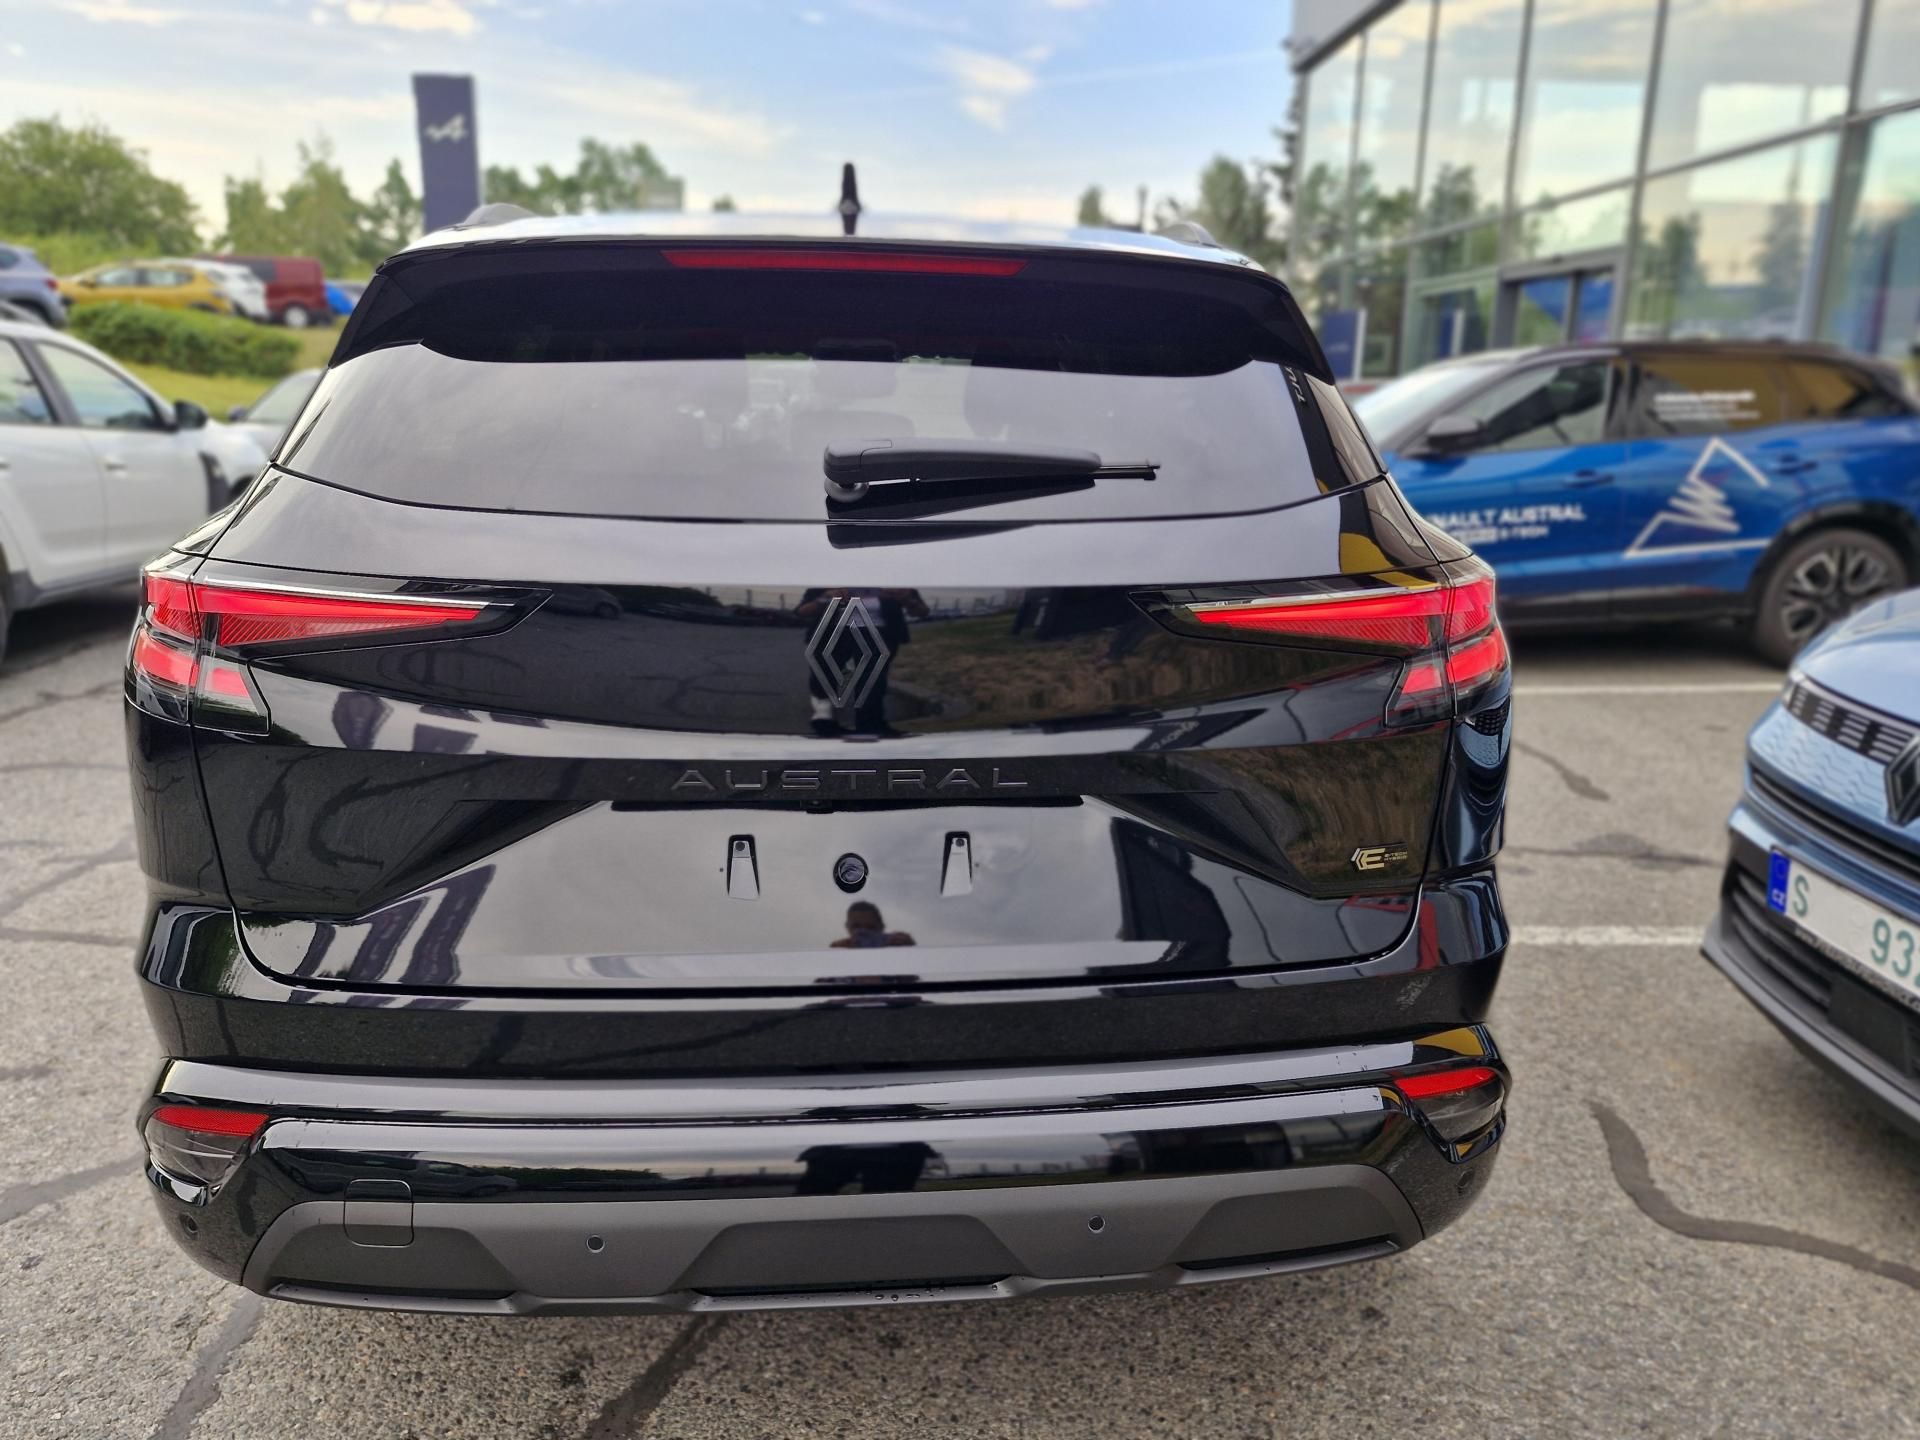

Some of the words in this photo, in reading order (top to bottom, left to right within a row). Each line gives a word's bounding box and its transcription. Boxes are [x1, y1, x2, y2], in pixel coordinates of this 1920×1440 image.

[671, 768, 1030, 792] AUSTRAL
[1792, 874, 1810, 918] S
[1870, 917, 1920, 988] 93
